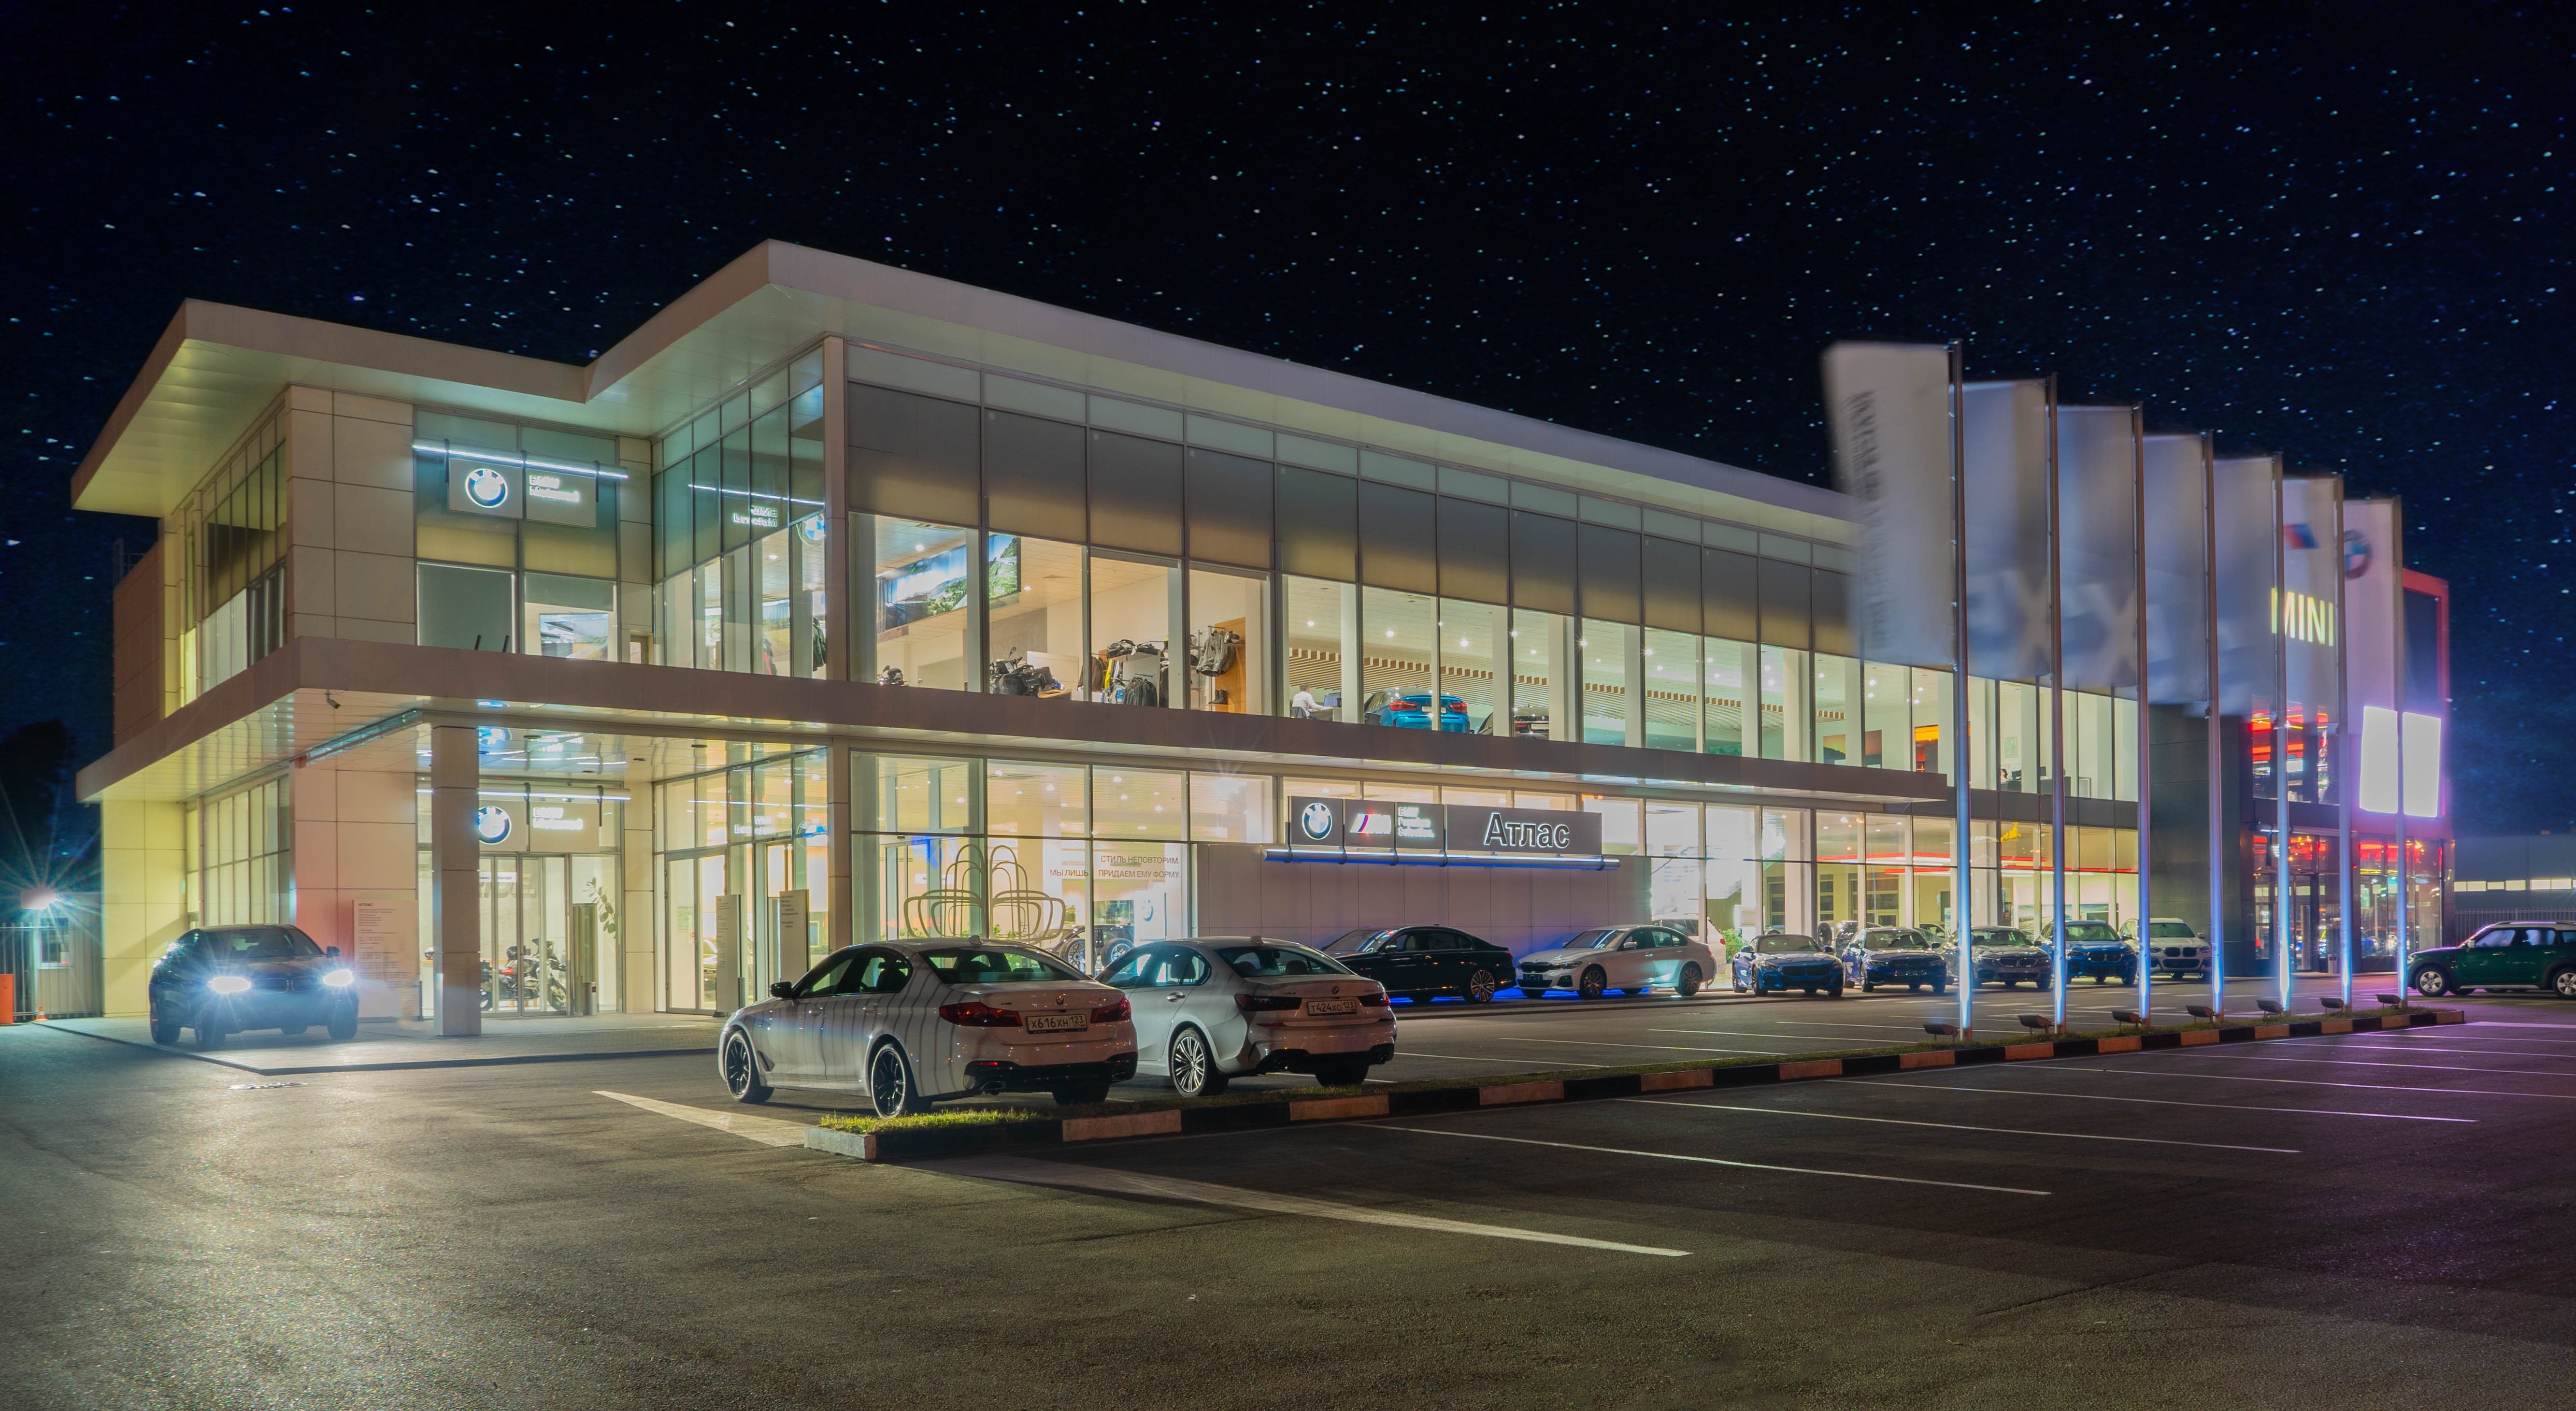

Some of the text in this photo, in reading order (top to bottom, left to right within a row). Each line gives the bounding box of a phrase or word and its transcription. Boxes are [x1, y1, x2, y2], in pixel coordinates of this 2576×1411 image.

[2271, 588, 2334, 647] MINI
[1483, 812, 1570, 849] Атлас
[1098, 870, 1135, 878] ПРИДАЕМ
[1070, 1016, 1083, 1024] 123
